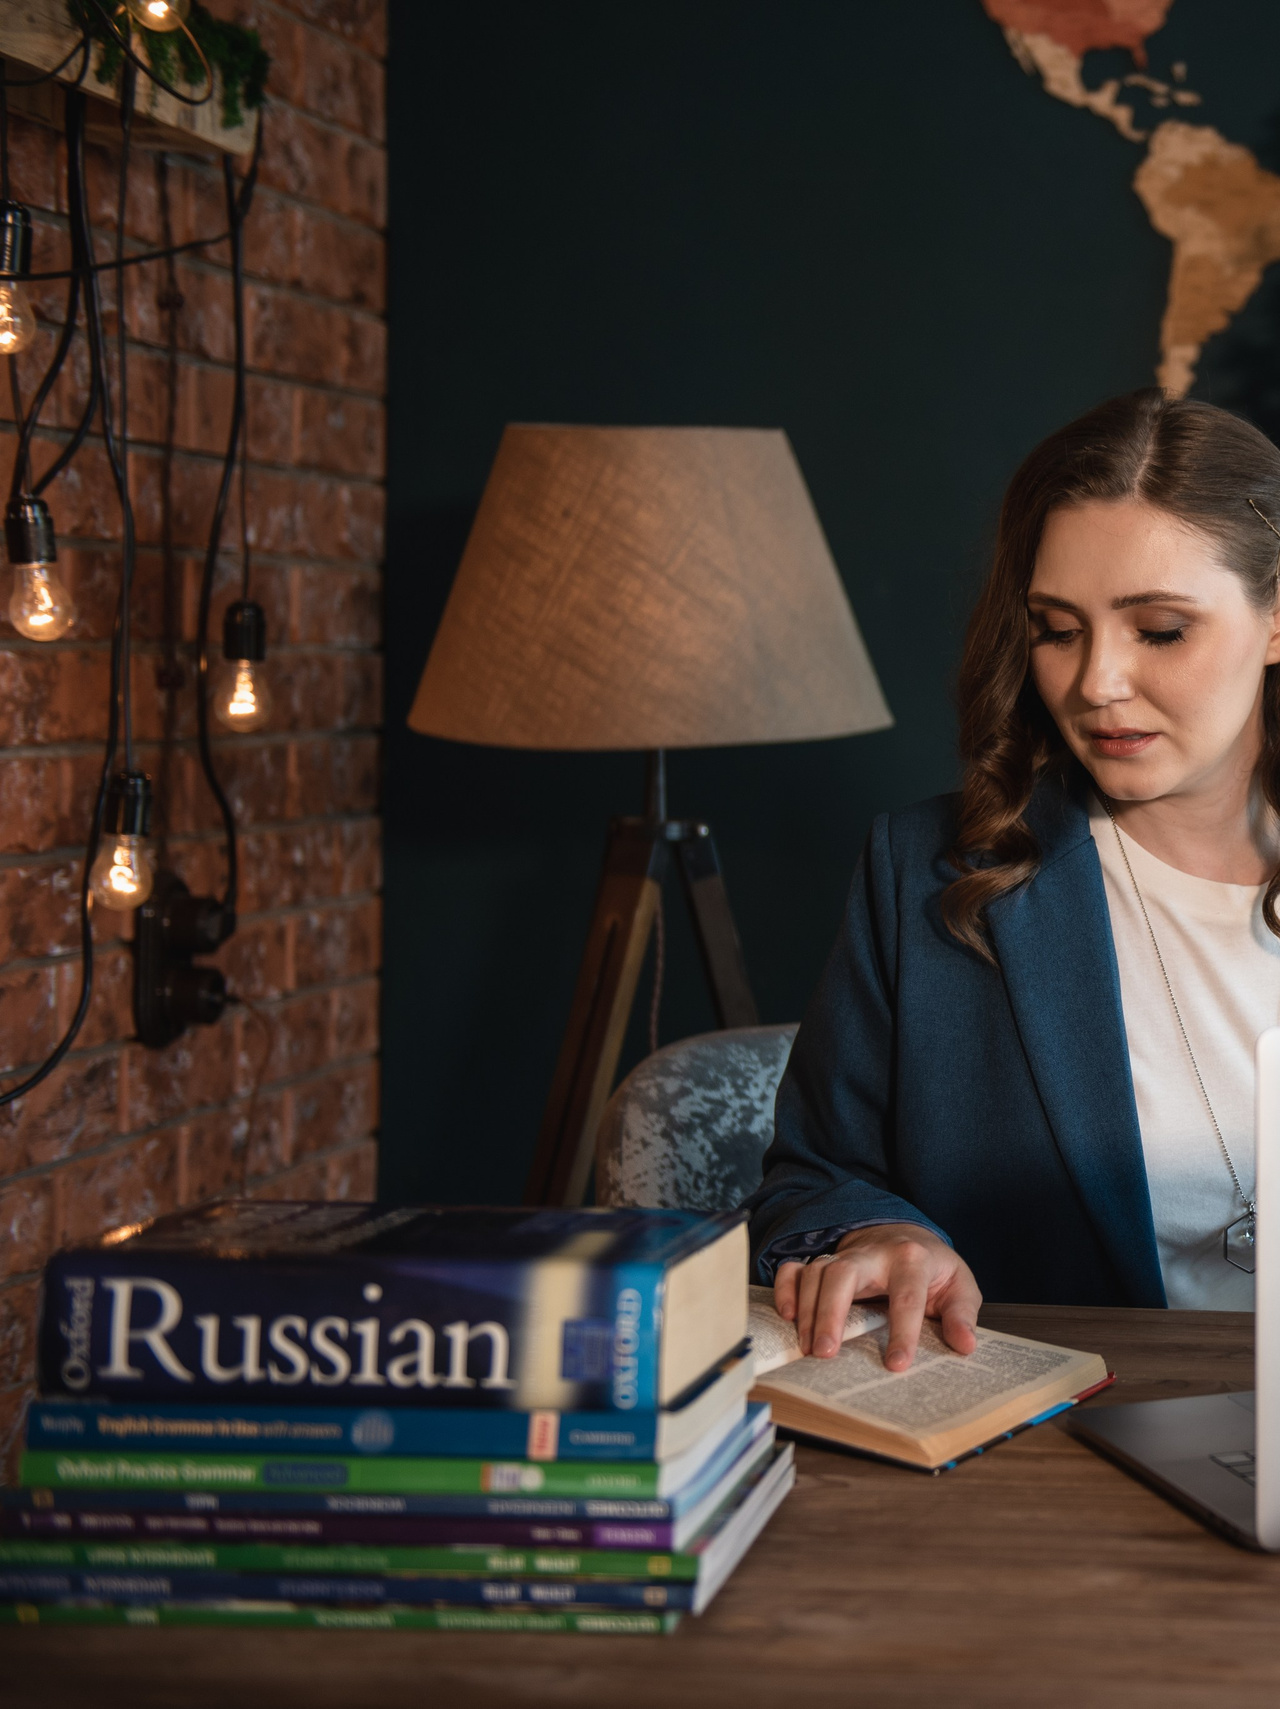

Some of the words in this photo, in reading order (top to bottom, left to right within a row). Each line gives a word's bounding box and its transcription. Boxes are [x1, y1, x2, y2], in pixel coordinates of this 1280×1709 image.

[62, 1276, 96, 1391] Oxford
[99, 1276, 516, 1391] Russian
[613, 1287, 643, 1410] OXFORD
